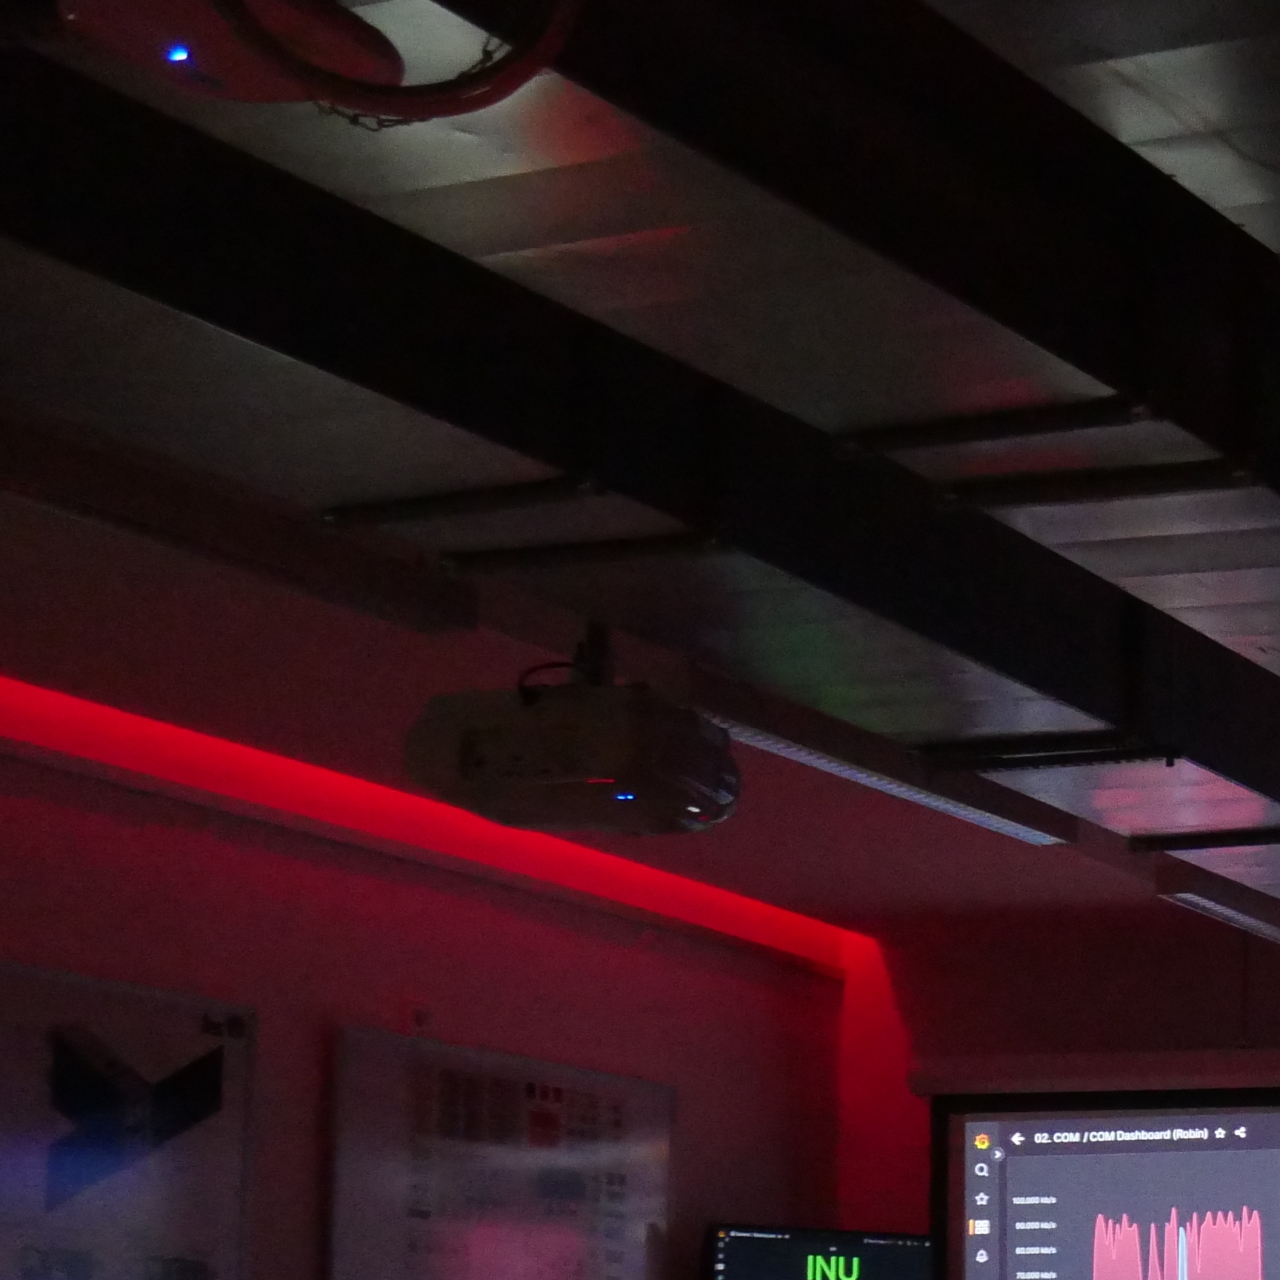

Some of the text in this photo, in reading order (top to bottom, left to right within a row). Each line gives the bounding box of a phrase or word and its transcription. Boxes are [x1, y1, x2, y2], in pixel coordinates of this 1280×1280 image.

[1035, 1134, 1051, 1143] 02.
[1054, 1133, 1079, 1143] COM
[1090, 1132, 1115, 1142] COM
[1117, 1130, 1170, 1141] Dashboard
[1173, 1128, 1208, 1140] (Robin)
